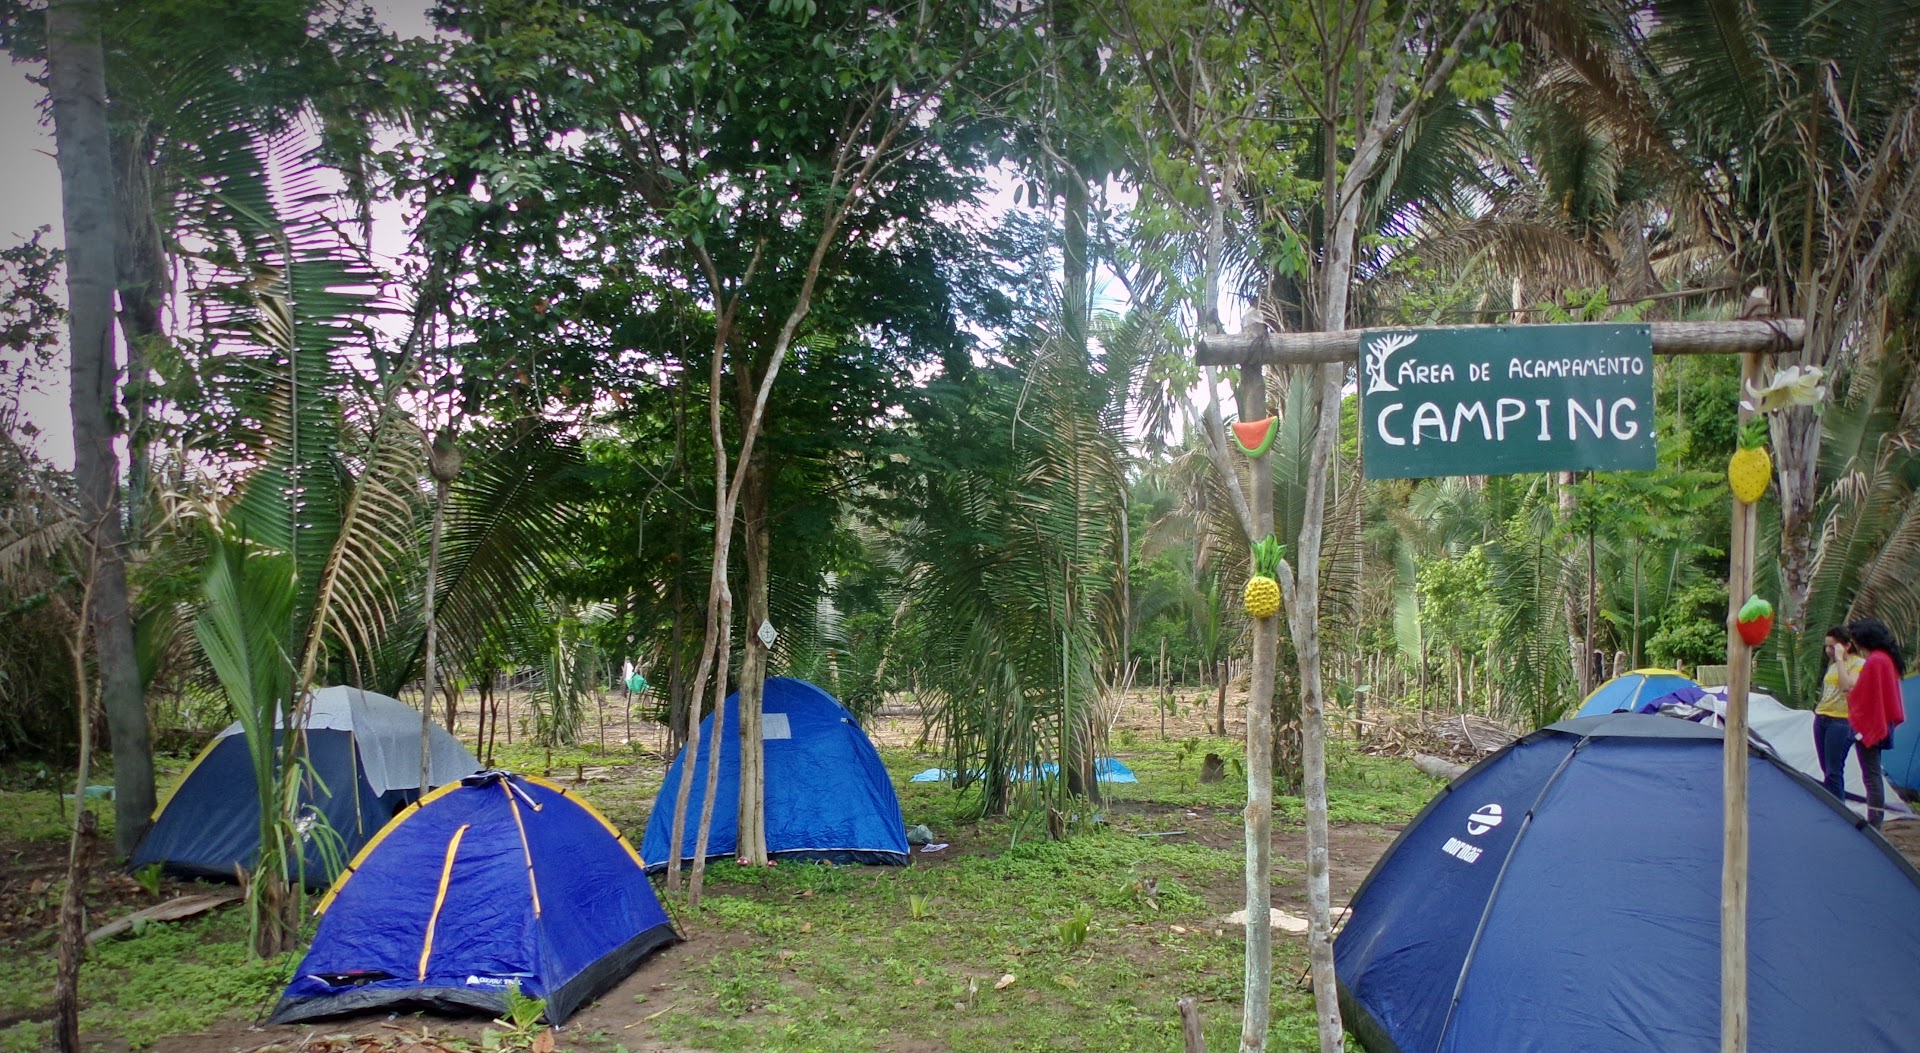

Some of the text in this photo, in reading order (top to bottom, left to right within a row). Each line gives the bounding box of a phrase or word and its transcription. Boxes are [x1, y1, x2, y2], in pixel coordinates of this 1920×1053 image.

[1398, 357, 1644, 385] ÁREA DE ACAMPAMENTO
[1377, 398, 1639, 446] CAMPING
